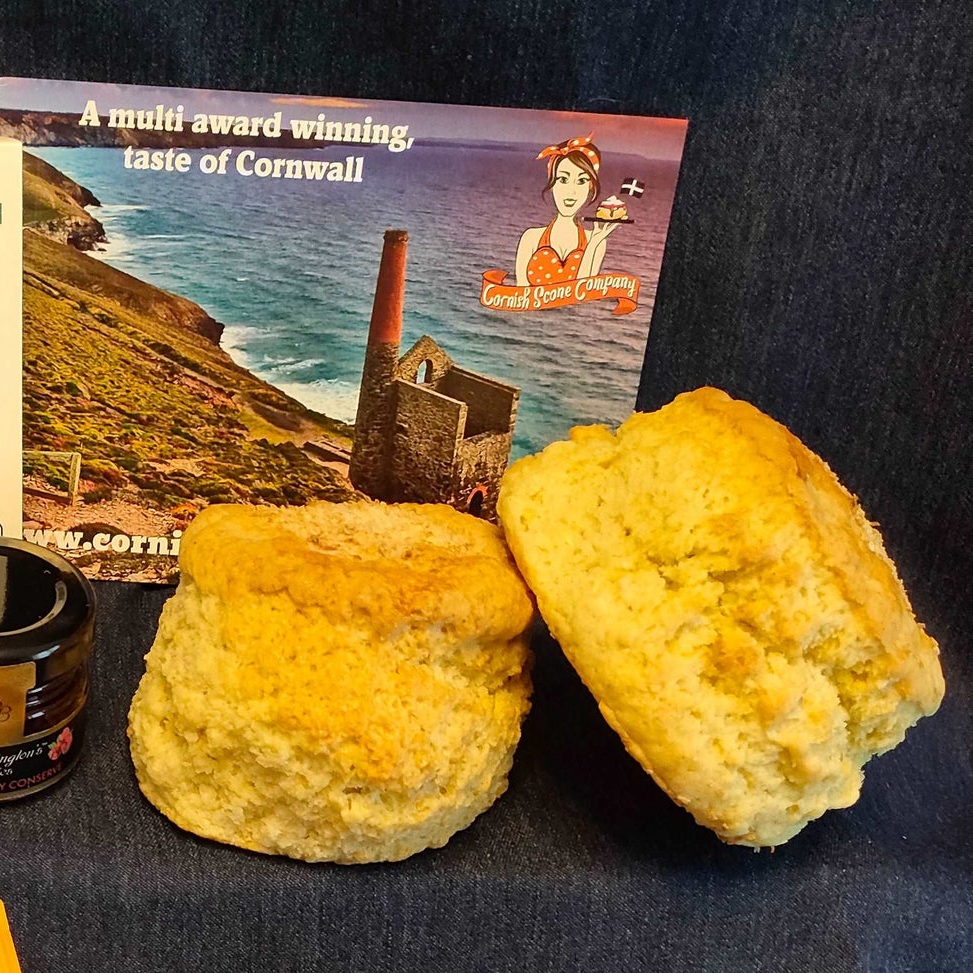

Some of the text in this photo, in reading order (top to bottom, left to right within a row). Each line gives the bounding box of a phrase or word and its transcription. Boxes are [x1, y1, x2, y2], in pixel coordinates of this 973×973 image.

[79, 100, 414, 153] A multi award winning,
[123, 145, 364, 183] taste of Cornwall
[482, 276, 636, 309] Cornish Scone Company
[8, 763, 62, 789] CONSERVE
